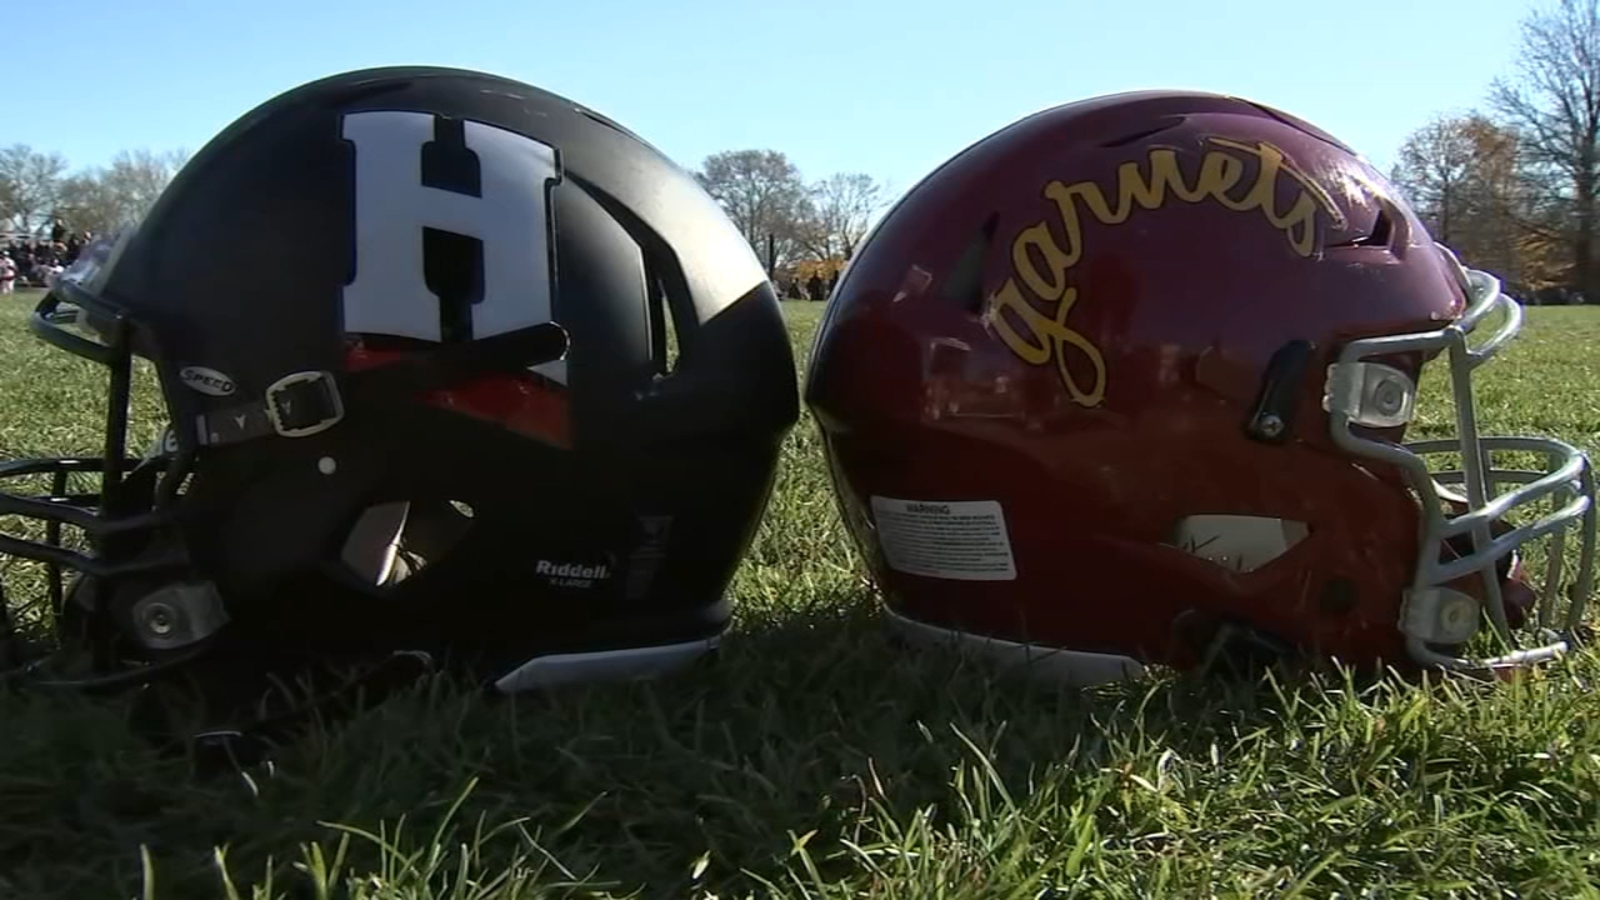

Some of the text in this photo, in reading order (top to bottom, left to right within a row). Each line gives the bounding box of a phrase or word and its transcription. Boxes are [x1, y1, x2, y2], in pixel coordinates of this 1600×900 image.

[341, 110, 562, 342] H
[988, 136, 1346, 408] garnets
[183, 369, 233, 392] SPEED
[536, 560, 607, 579] Riddell
